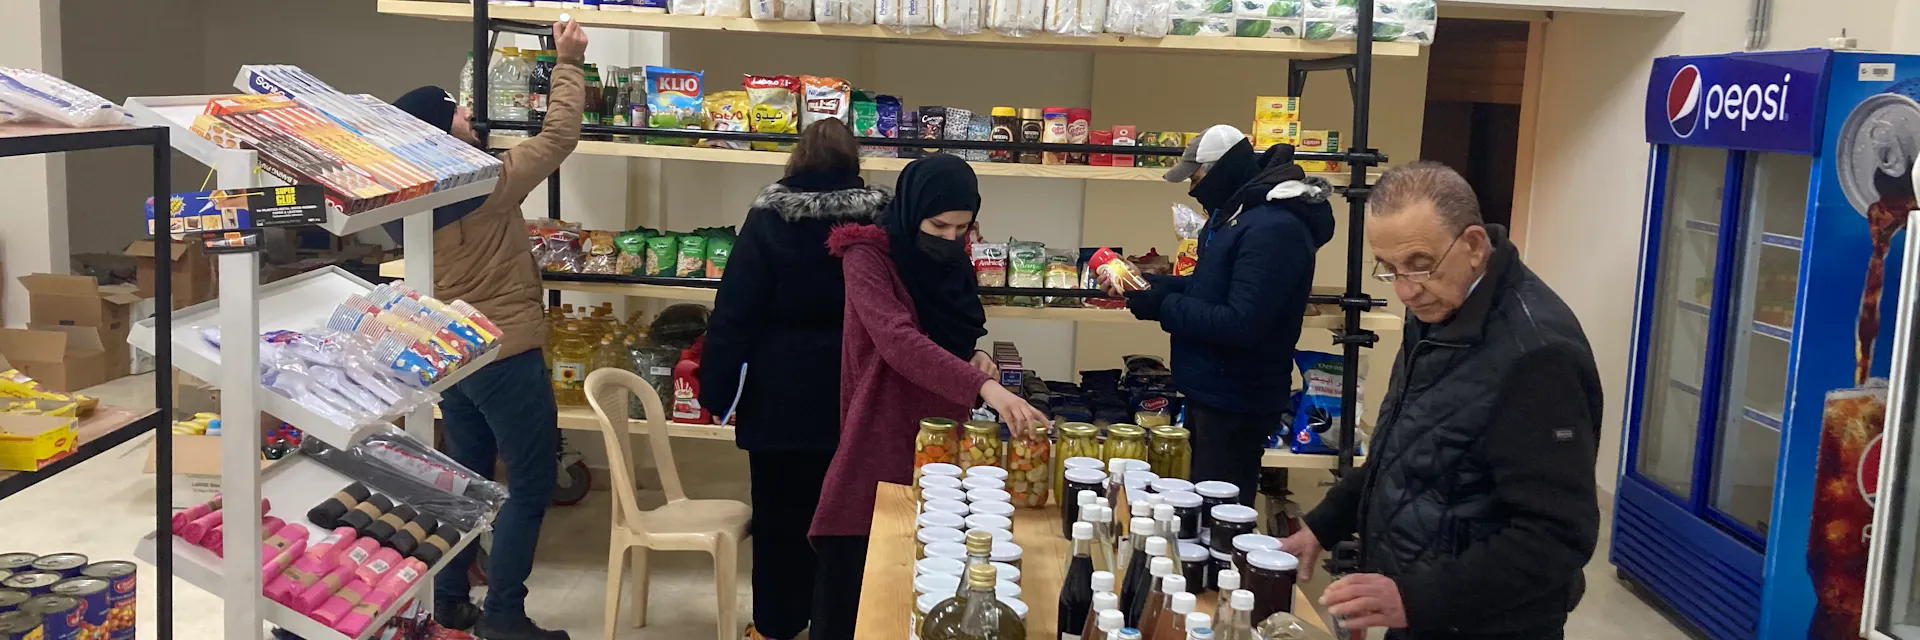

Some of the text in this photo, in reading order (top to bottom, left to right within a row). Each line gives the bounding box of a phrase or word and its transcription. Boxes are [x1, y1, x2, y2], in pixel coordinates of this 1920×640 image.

[659, 77, 698, 92] KLIO
[1704, 73, 1791, 132] pepsi
[756, 112, 783, 123] نيدو
[275, 187, 295, 195] SUPER
[276, 194, 297, 206] GLUE
